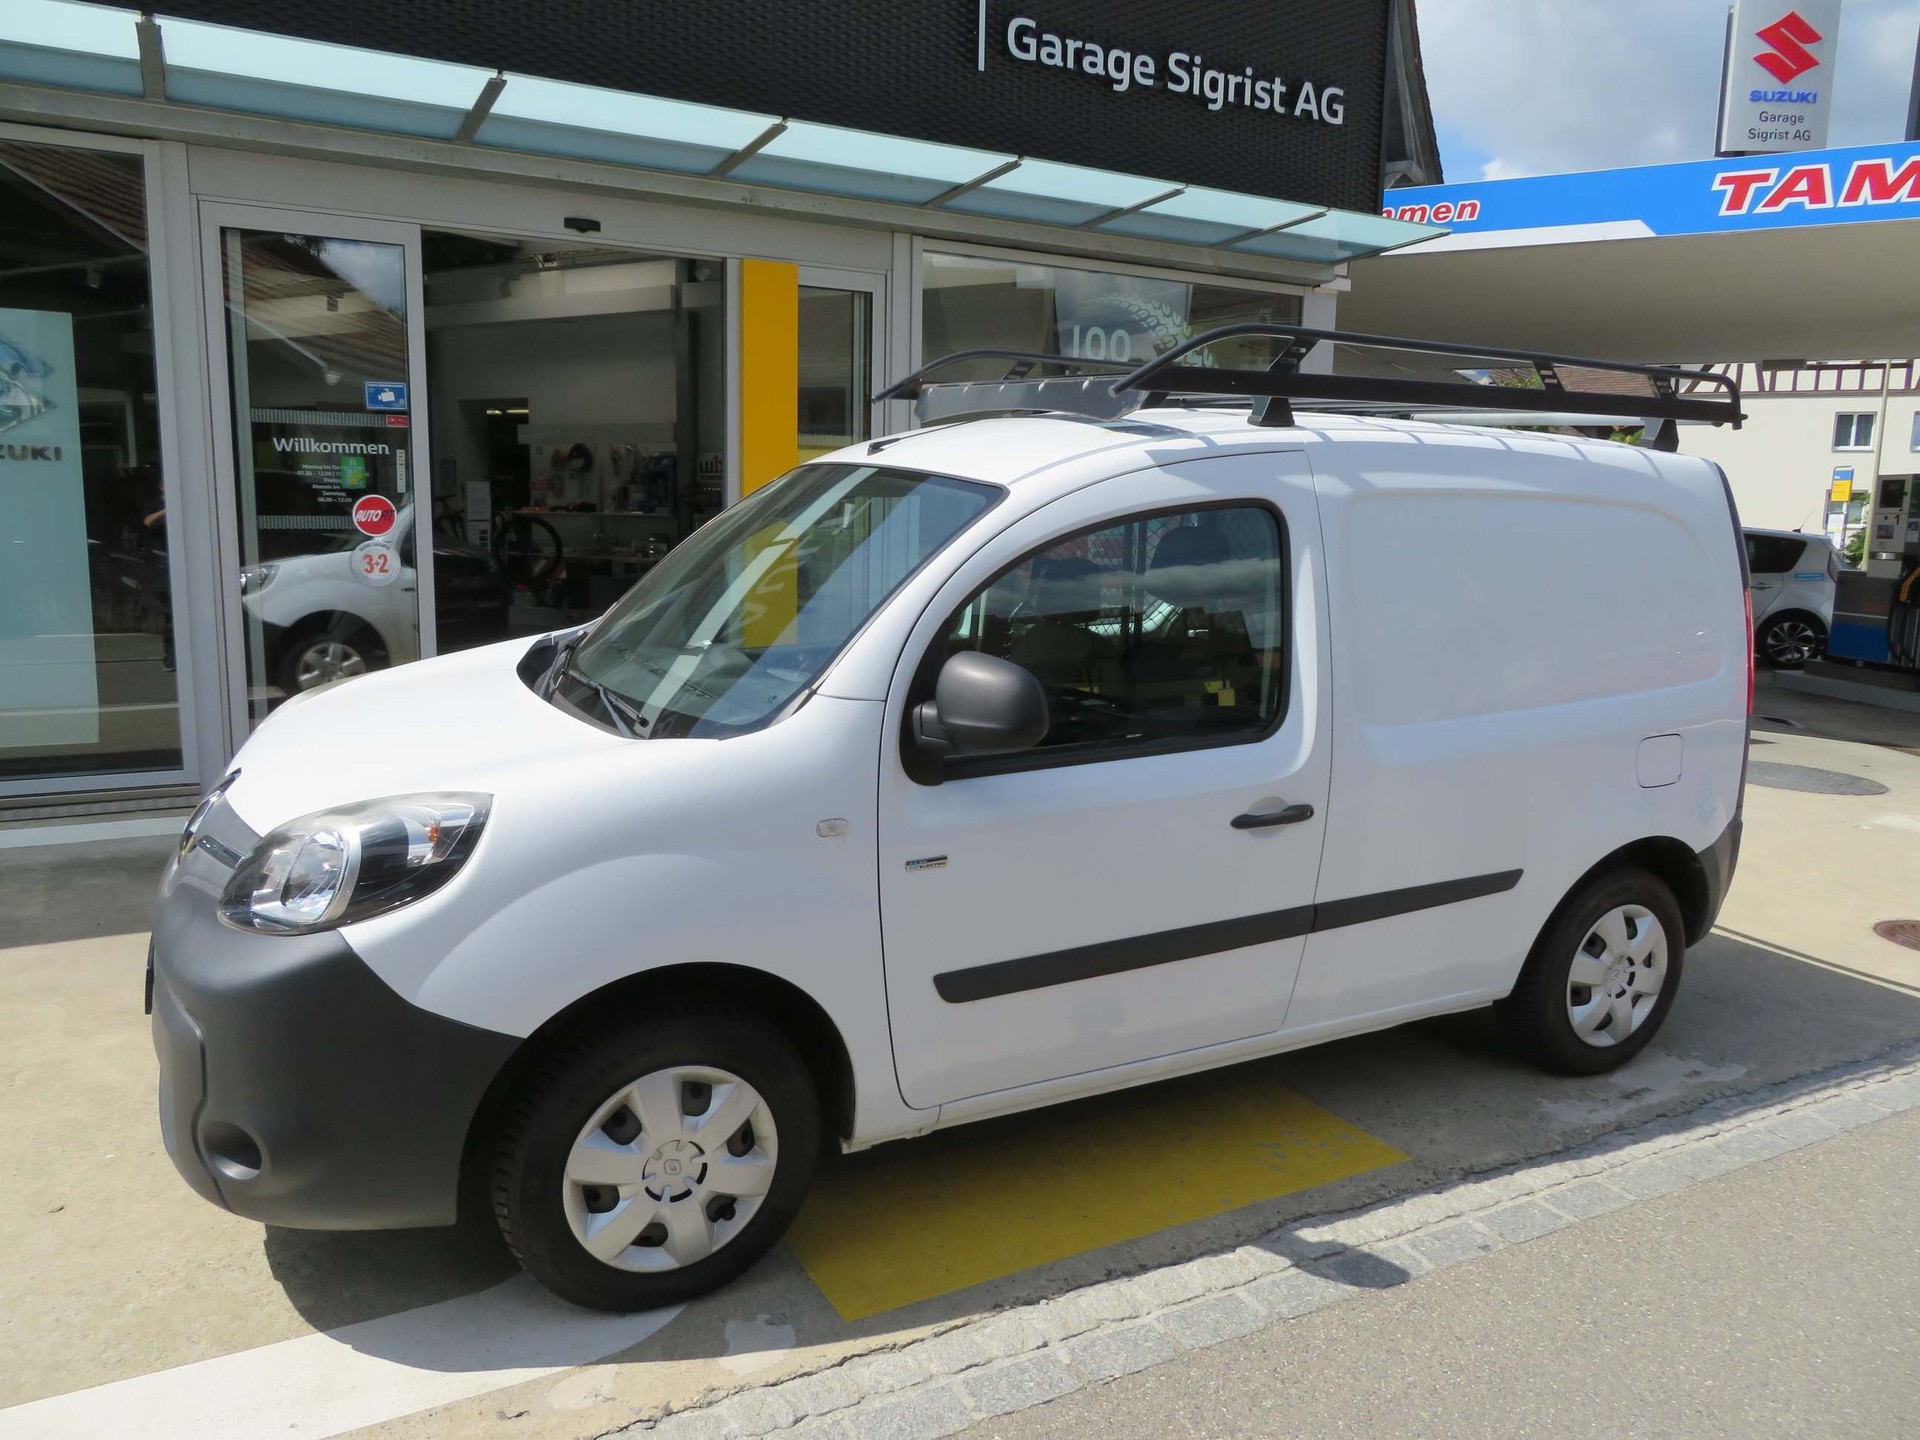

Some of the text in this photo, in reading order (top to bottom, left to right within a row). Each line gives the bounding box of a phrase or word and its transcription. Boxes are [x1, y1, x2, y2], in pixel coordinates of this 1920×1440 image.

[1007, 16, 1345, 125] Garage Sigrist AG
[1749, 90, 1818, 104] SUZUKI
[1759, 111, 1805, 126] Garage
[1748, 128, 1811, 142] Sigrist AG
[273, 437, 390, 455] Willkommen
